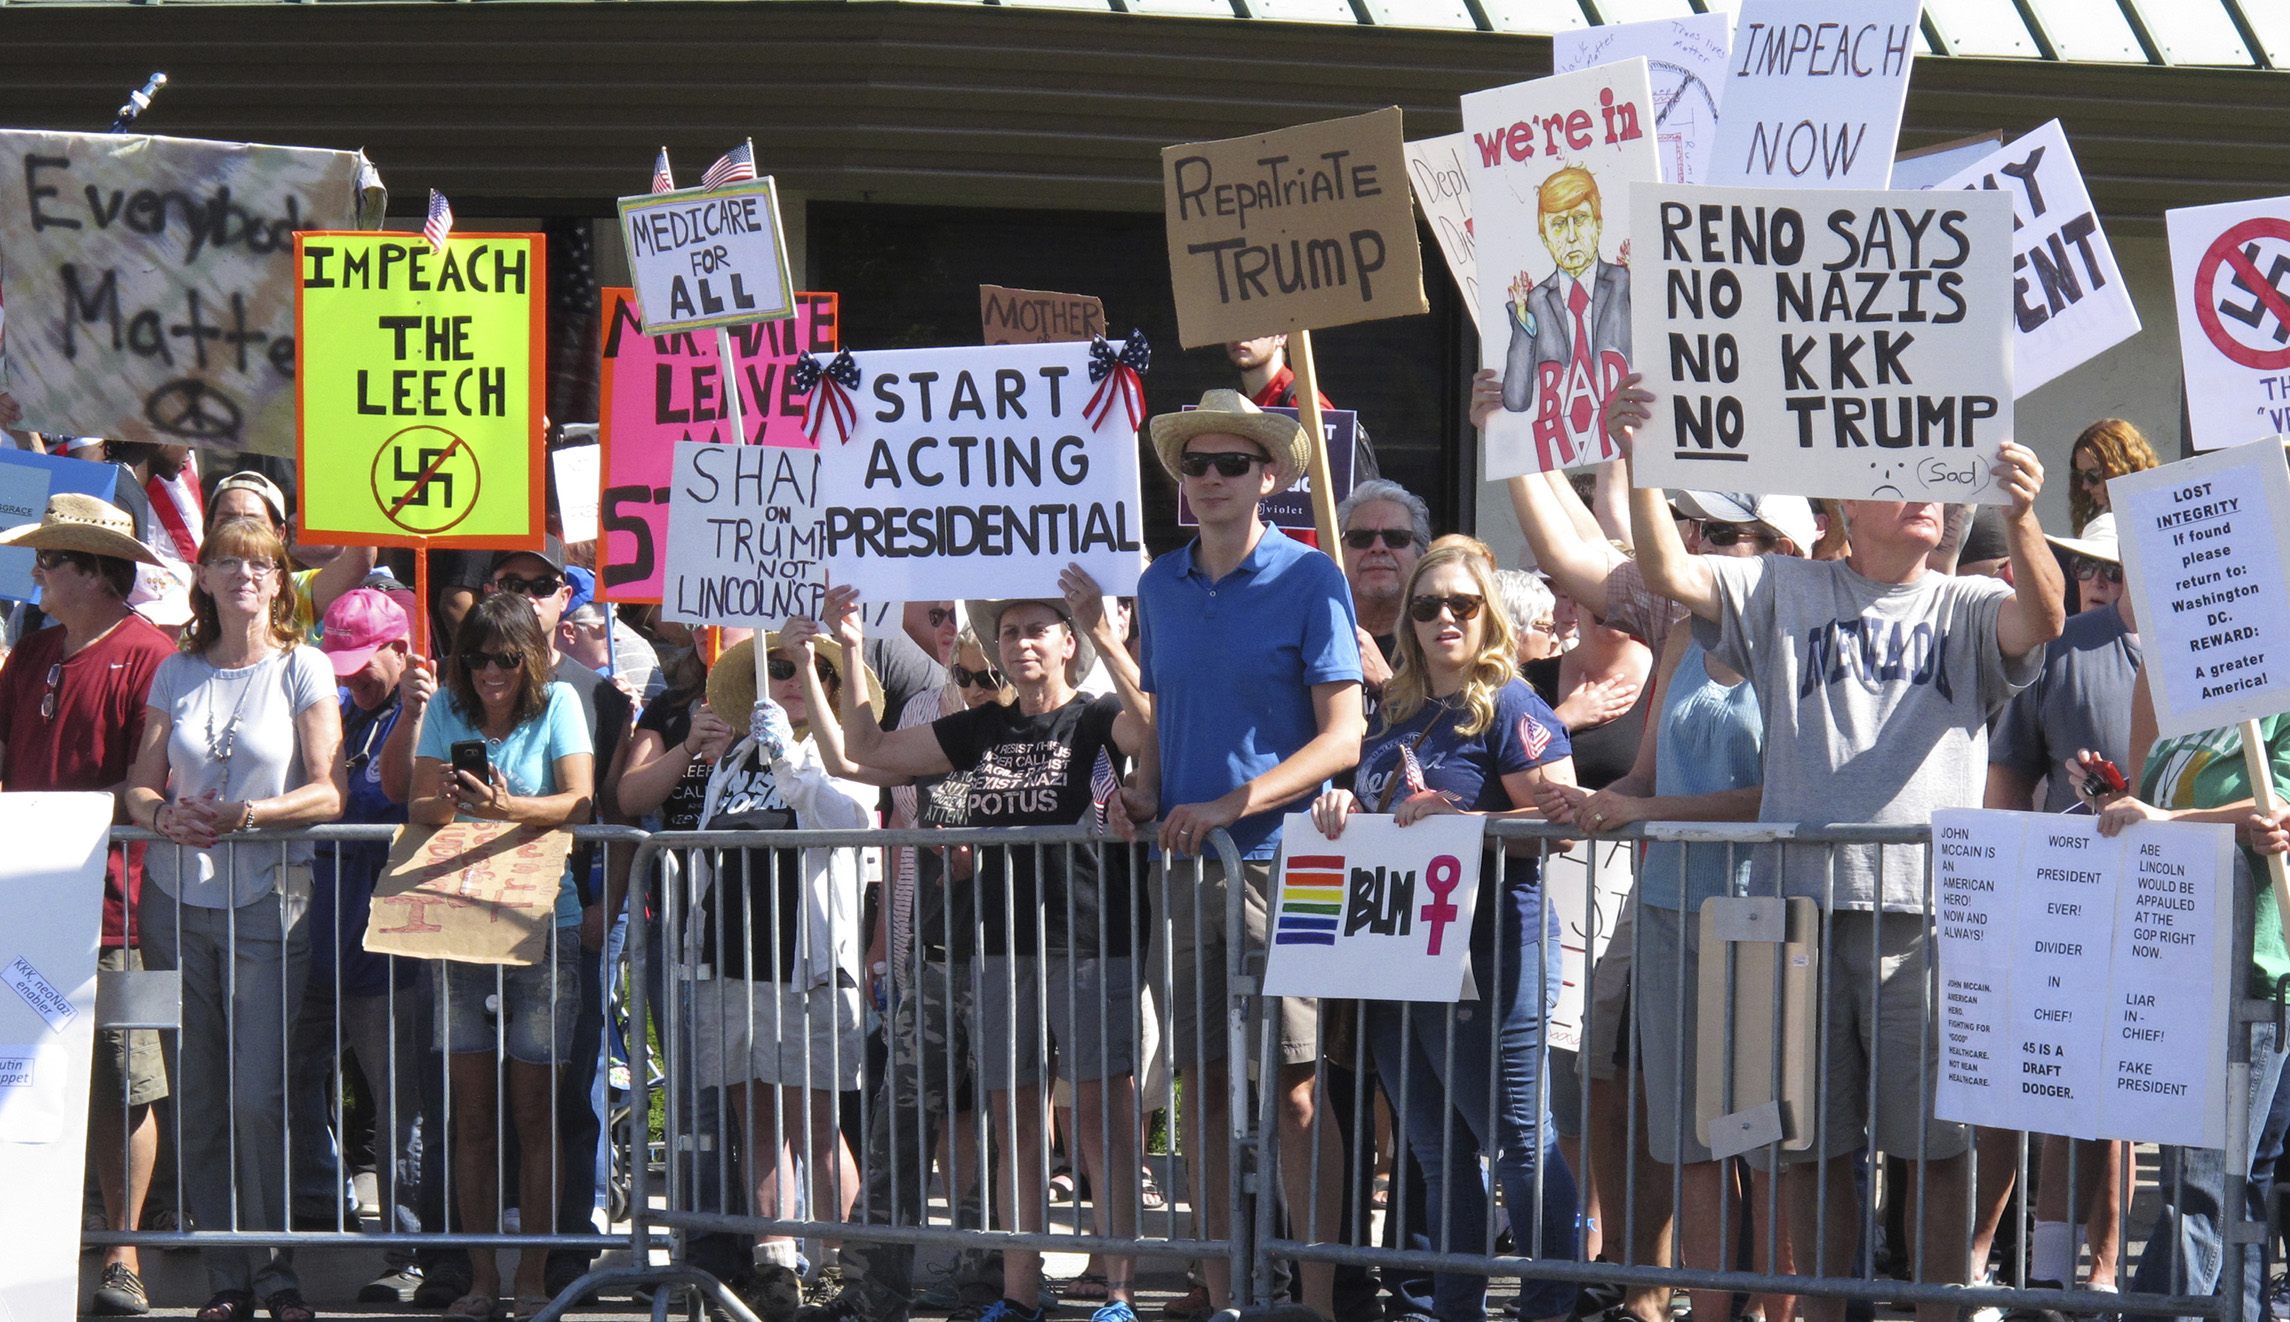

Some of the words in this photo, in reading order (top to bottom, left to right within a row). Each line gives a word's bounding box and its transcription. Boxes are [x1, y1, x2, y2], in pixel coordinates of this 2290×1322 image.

[1554, 40, 1591, 75] lack
[1737, 23, 1910, 77] IMPEACH
[1474, 109, 1593, 167] we're
[1600, 87, 1643, 145] in
[1746, 120, 1867, 180] NOW
[25, 153, 310, 266] Everybod
[632, 198, 762, 257] MEDICARE
[1660, 201, 1805, 266] RENO
[1822, 206, 1970, 271] SAYS
[304, 244, 527, 294] IMPEACH
[690, 245, 731, 277] FOR
[671, 273, 756, 320] ALL
[1667, 268, 1742, 319] NO
[1776, 270, 1967, 323] NAZIS
[984, 293, 1100, 338] MOTHER
[379, 316, 474, 361] THE
[1668, 332, 1739, 383] NO
[1781, 330, 1915, 390] KKK
[357, 367, 506, 417] LEECH
[873, 366, 1070, 422] START
[1538, 351, 1629, 422] BAD
[1673, 394, 1744, 449] NO
[1786, 395, 1999, 448] TRUMP
[864, 435, 1089, 489] ACTING
[2173, 483, 2212, 502] LOST
[765, 506, 791, 524] ON
[1266, 506, 1303, 515] violet
[2156, 498, 2239, 529] INTEGRITY
[825, 501, 1141, 557] PRESIDENTIAL
[2173, 532, 2184, 546] If
[2189, 522, 2231, 542] found
[2182, 546, 2231, 568] please
[757, 559, 817, 580] NOT
[2176, 572, 2221, 591] return
[2226, 565, 2247, 578] to:
[2172, 584, 2259, 613] Washington
[2207, 611, 2233, 626] DC.
[2190, 626, 2260, 652] REWARD:
[2195, 667, 2205, 679] A
[2210, 653, 2264, 677] greater
[2202, 672, 2268, 699] America!
[1023, 771, 1068, 788] NAZI
[967, 789, 1058, 817] POTUS
[1941, 827, 1969, 840] JOHN
[2049, 835, 2090, 849] WORST
[1942, 844, 1982, 858] MCCAIN
[1985, 847, 1996, 858] IS
[2140, 843, 2160, 857] ABE
[1942, 860, 1954, 872] AN
[2139, 860, 2185, 876] LINCOLN
[1943, 877, 1995, 891] AMERICAN
[2037, 868, 2102, 884] PRESIDENT
[2138, 877, 2176, 892] WOULD
[2180, 882, 2195, 894] BE
[1344, 866, 1416, 937] BLM
[1944, 894, 1971, 907] HERO!
[2047, 902, 2082, 916] EVER!
[2136, 894, 2195, 911] APPAULED
[1943, 910, 1965, 922] NOW
[1967, 912, 1988, 925] AND
[2134, 911, 2150, 923] AT
[2152, 913, 2173, 926] THE
[1944, 926, 1984, 941] ALWAYS!
[2133, 928, 2157, 941] GOP
[2159, 931, 2196, 945] RIGHT
[2035, 941, 2083, 956] DIVIDER
[2132, 945, 2163, 959] NOW.
[13, 959, 37, 982] KKK,
[34, 981, 74, 1018] neoNazi
[2048, 976, 2061, 988] IN
[16, 981, 54, 1015] enabler
[1948, 993, 1978, 1004] AMERICAN
[2126, 993, 2155, 1007] LIAR
[2034, 1008, 2072, 1022] CHIEF!
[1948, 1019, 1974, 1031] FIGHTING
[1976, 1024, 1991, 1032] FOR
[2122, 1027, 2164, 1042] CHIEF!
[2022, 1042, 2036, 1054] 45
[2039, 1043, 2051, 1055] IS
[2055, 1045, 2064, 1057] A
[2022, 1061, 2061, 1077] DRAFT
[2119, 1060, 2153, 1075] FAKE
[0, 1073, 28, 1085] ppet
[2117, 1077, 2188, 1096] PRESIDENT
[2022, 1082, 2074, 1099] DODGER.
